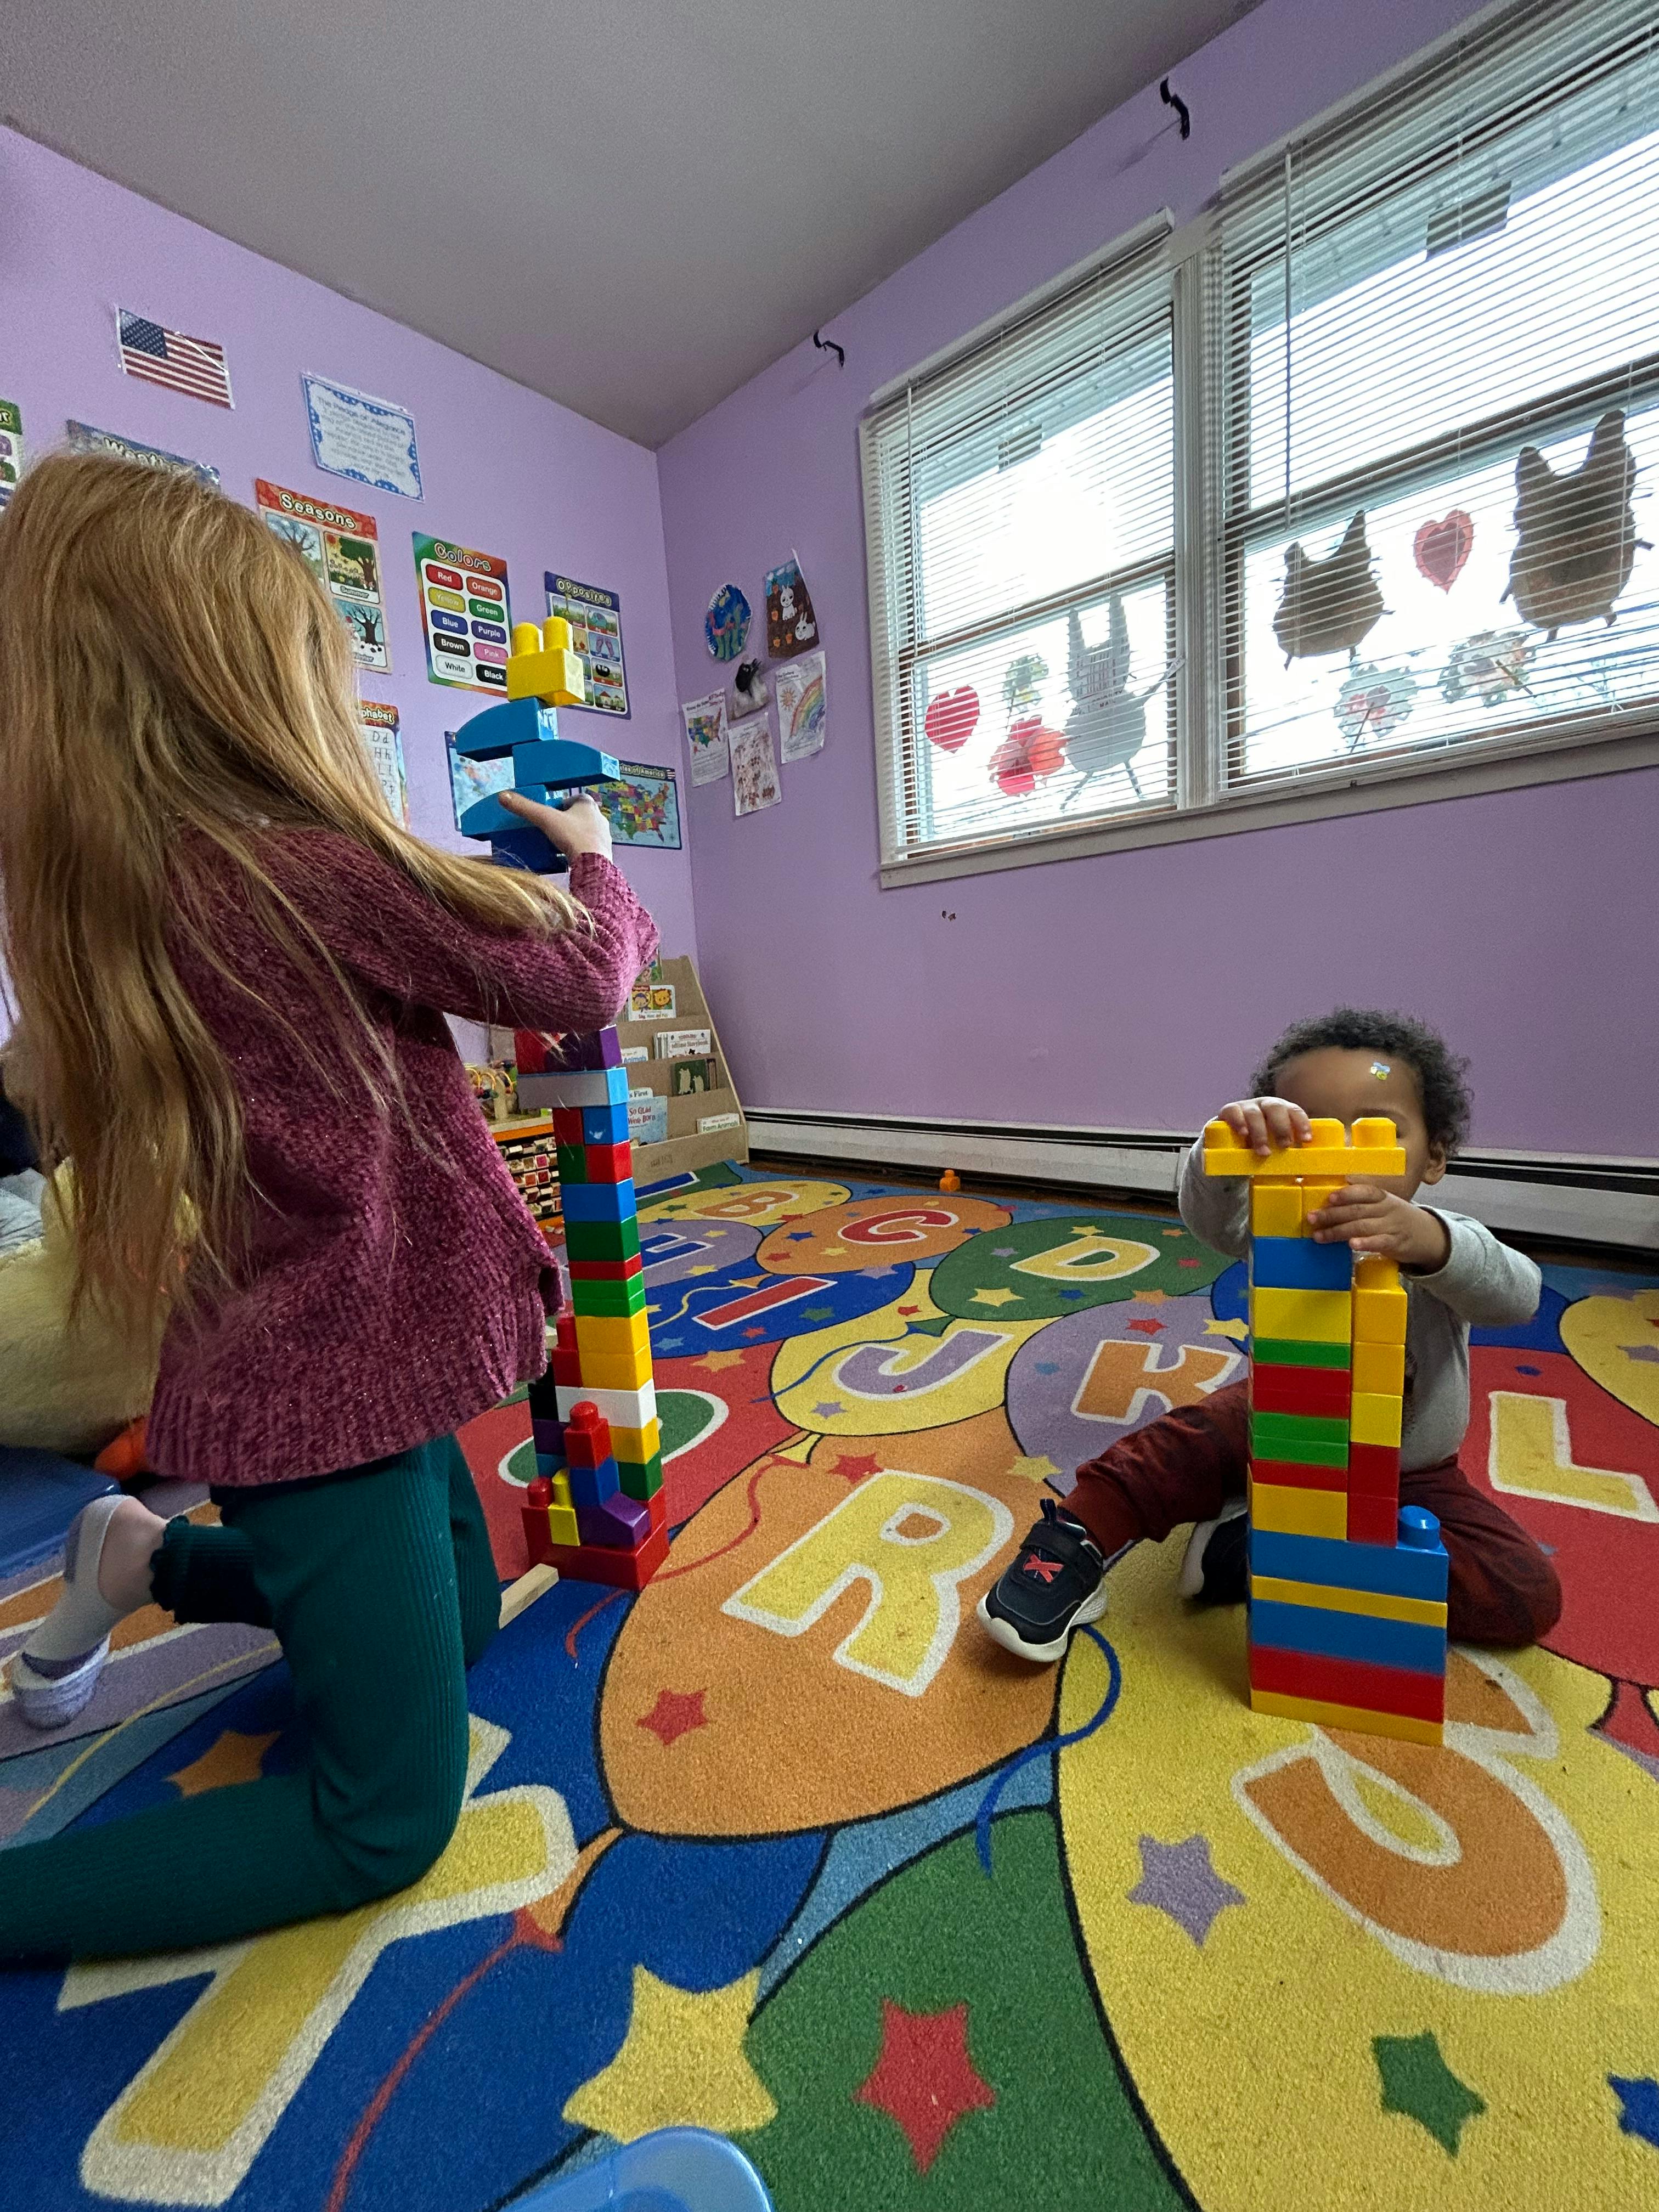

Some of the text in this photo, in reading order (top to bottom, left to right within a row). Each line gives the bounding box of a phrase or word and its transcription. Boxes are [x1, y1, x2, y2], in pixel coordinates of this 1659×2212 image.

[280, 493, 356, 529] Seasons
[435, 543, 492, 572] Colors
[437, 571, 452, 583] Red
[472, 581, 498, 596] Orange
[436, 592, 459, 606] Yellow
[477, 604, 498, 616] Green
[442, 617, 459, 628] Blue
[478, 625, 501, 638] Purple
[441, 638, 465, 651] Brown
[484, 648, 500, 658] Pink
[445, 661, 465, 673] White
[484, 670, 504, 681] Black
[641, 767, 665, 778] America
[718, 1120, 738, 1129] Animals
[691, 1189, 800, 1221] B
[837, 1208, 960, 1245] C
[1009, 1235, 1162, 1282] D
[832, 1328, 1014, 1401] J
[1070, 1338, 1244, 1425] K
[1487, 1389, 1659, 1523] L
[720, 1468, 1016, 1698] R
